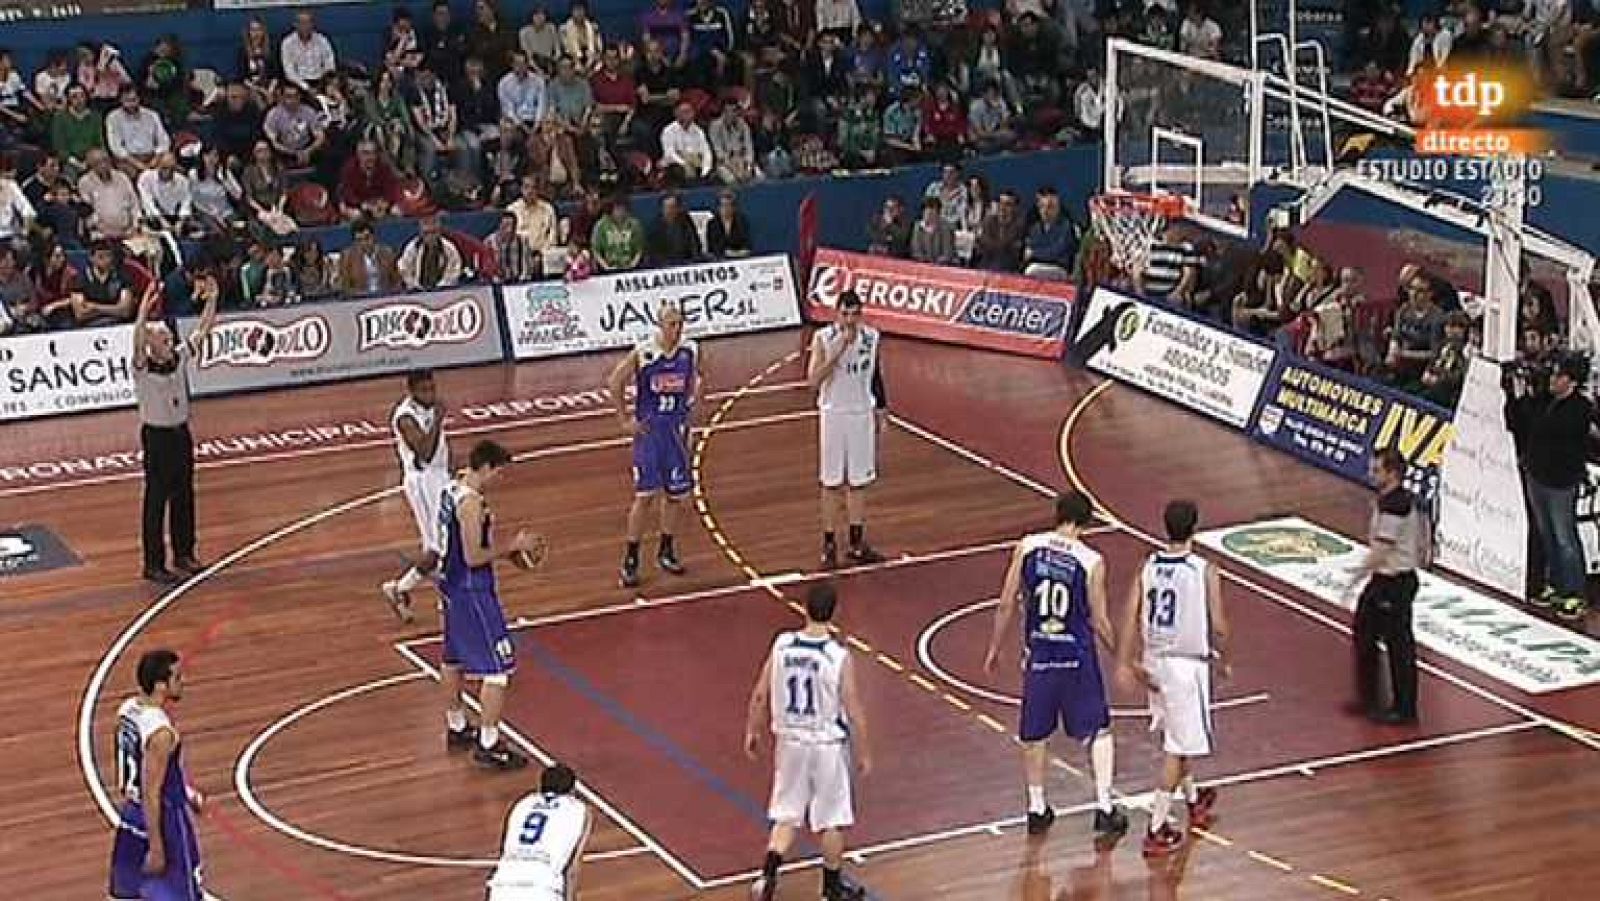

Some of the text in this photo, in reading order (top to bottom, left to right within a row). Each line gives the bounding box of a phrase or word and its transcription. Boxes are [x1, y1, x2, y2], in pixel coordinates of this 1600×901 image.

[614, 265, 740, 293] AISLAMIENTOS
[855, 279, 1051, 333] EROSKI center
[7, 356, 129, 393] SANCH
[1281, 366, 1384, 416] AUTOMOVILES
[54, 387, 132, 410] COMUNIO
[1034, 579, 1071, 619] 10
[1147, 586, 1176, 628] 13
[786, 675, 817, 716] 11
[519, 811, 549, 846] 9
